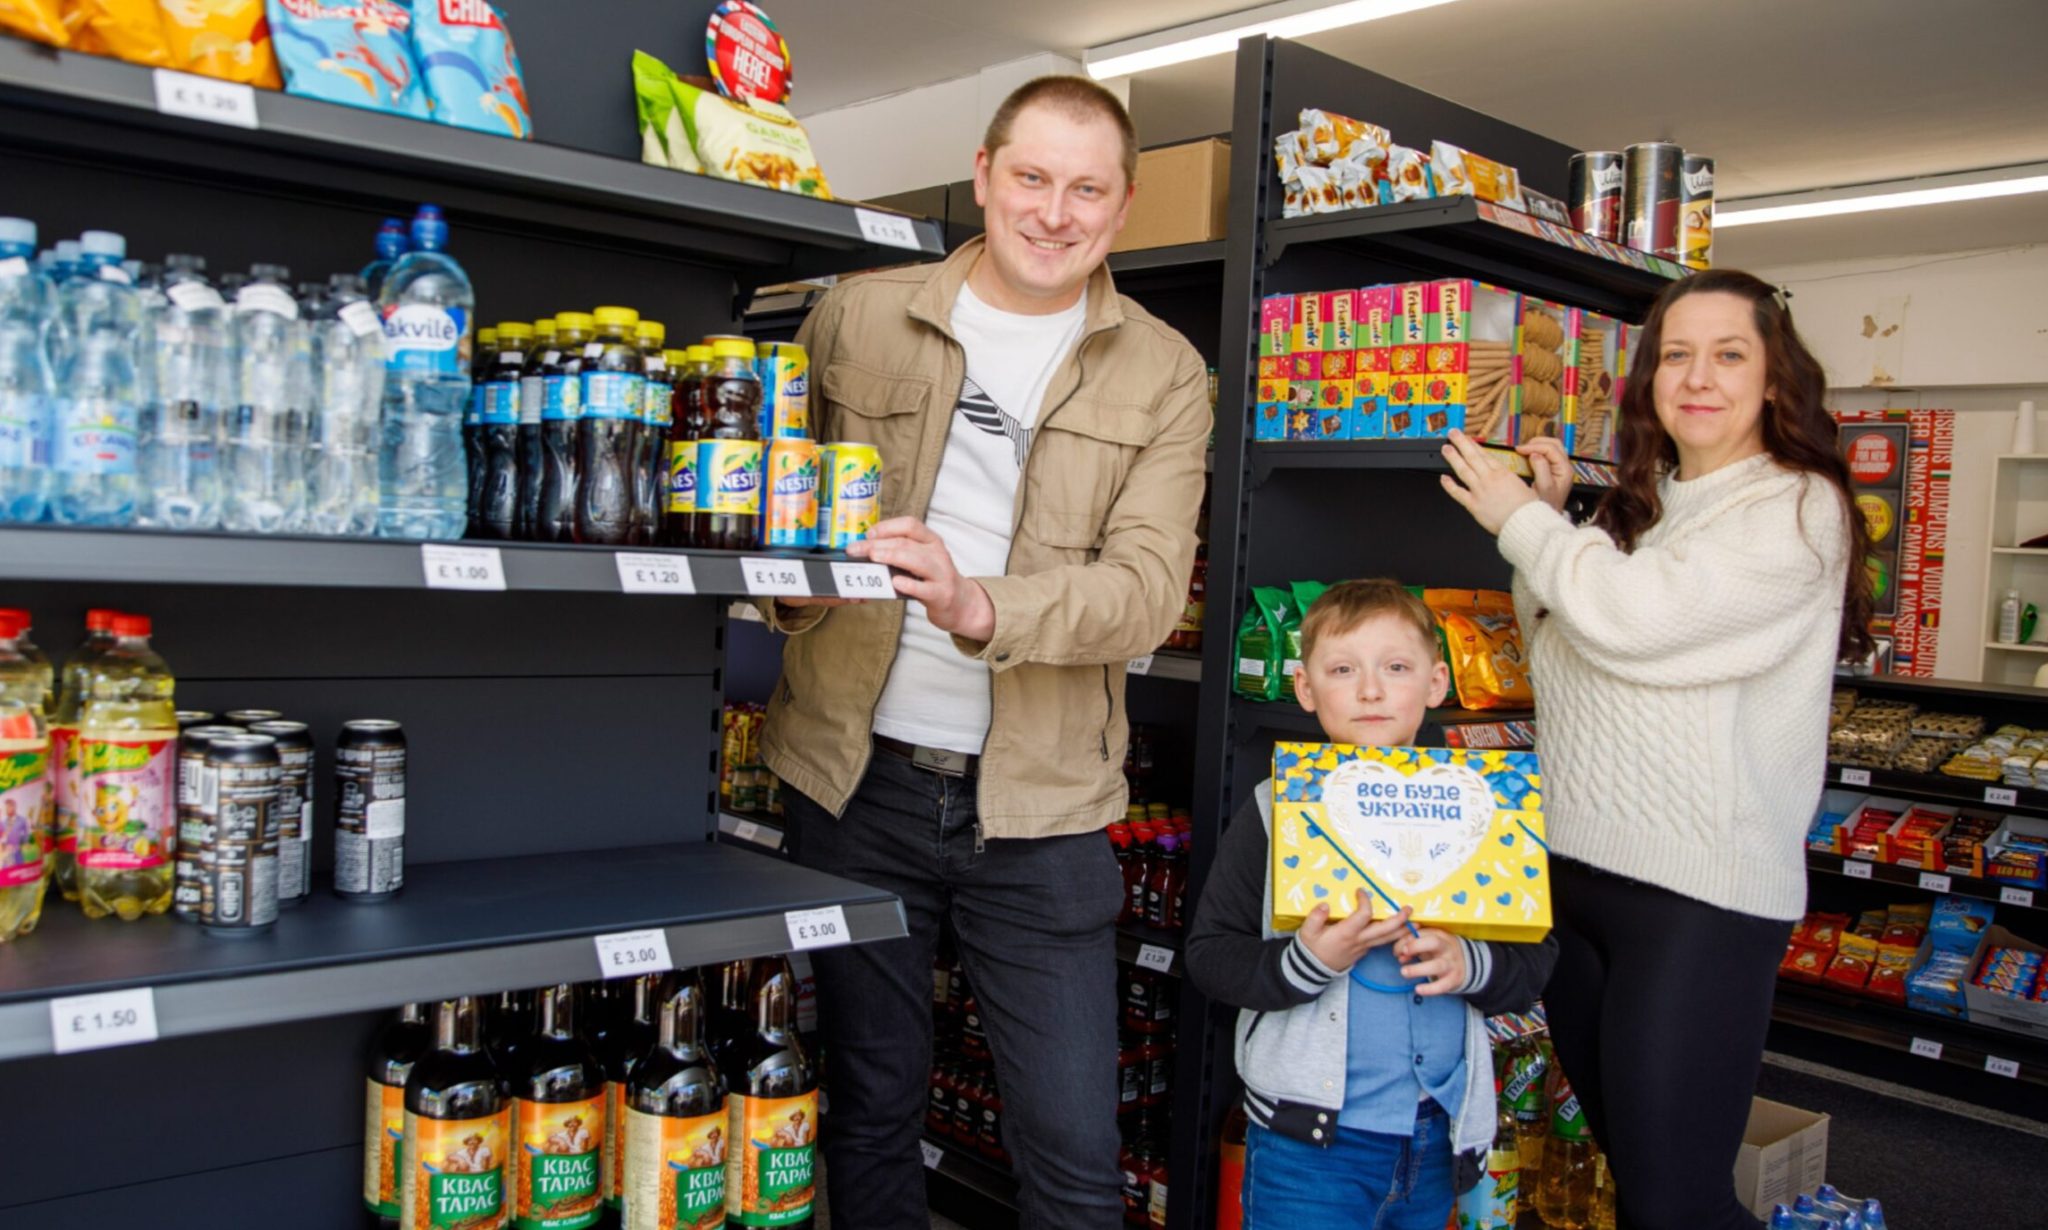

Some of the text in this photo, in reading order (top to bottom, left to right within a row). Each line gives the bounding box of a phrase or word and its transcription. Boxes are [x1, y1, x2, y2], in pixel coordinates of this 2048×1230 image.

[733, 44, 770, 90] HERE!
[1906, 455, 1929, 508] SNACKS
[1901, 524, 1923, 571] CAVIAR
[438, 565, 489, 580] £ 1.00
[636, 570, 680, 584] £ 1.20
[755, 571, 797, 585] £ 1.50
[845, 575, 883, 588] £ 1.00
[1921, 566, 1944, 610] VODKA
[798, 922, 837, 940] £ 3.00
[612, 948, 657, 966] £ 3.00
[72, 1008, 137, 1033] £ 1.50
[543, 1156, 593, 1176] КВАС
[771, 1149, 811, 1169] КВАС
[441, 1175, 494, 1196] КВАС
[537, 1171, 595, 1194] ТАРАС
[765, 1163, 814, 1187] ТАРАС
[436, 1190, 498, 1214] ТАРАС
